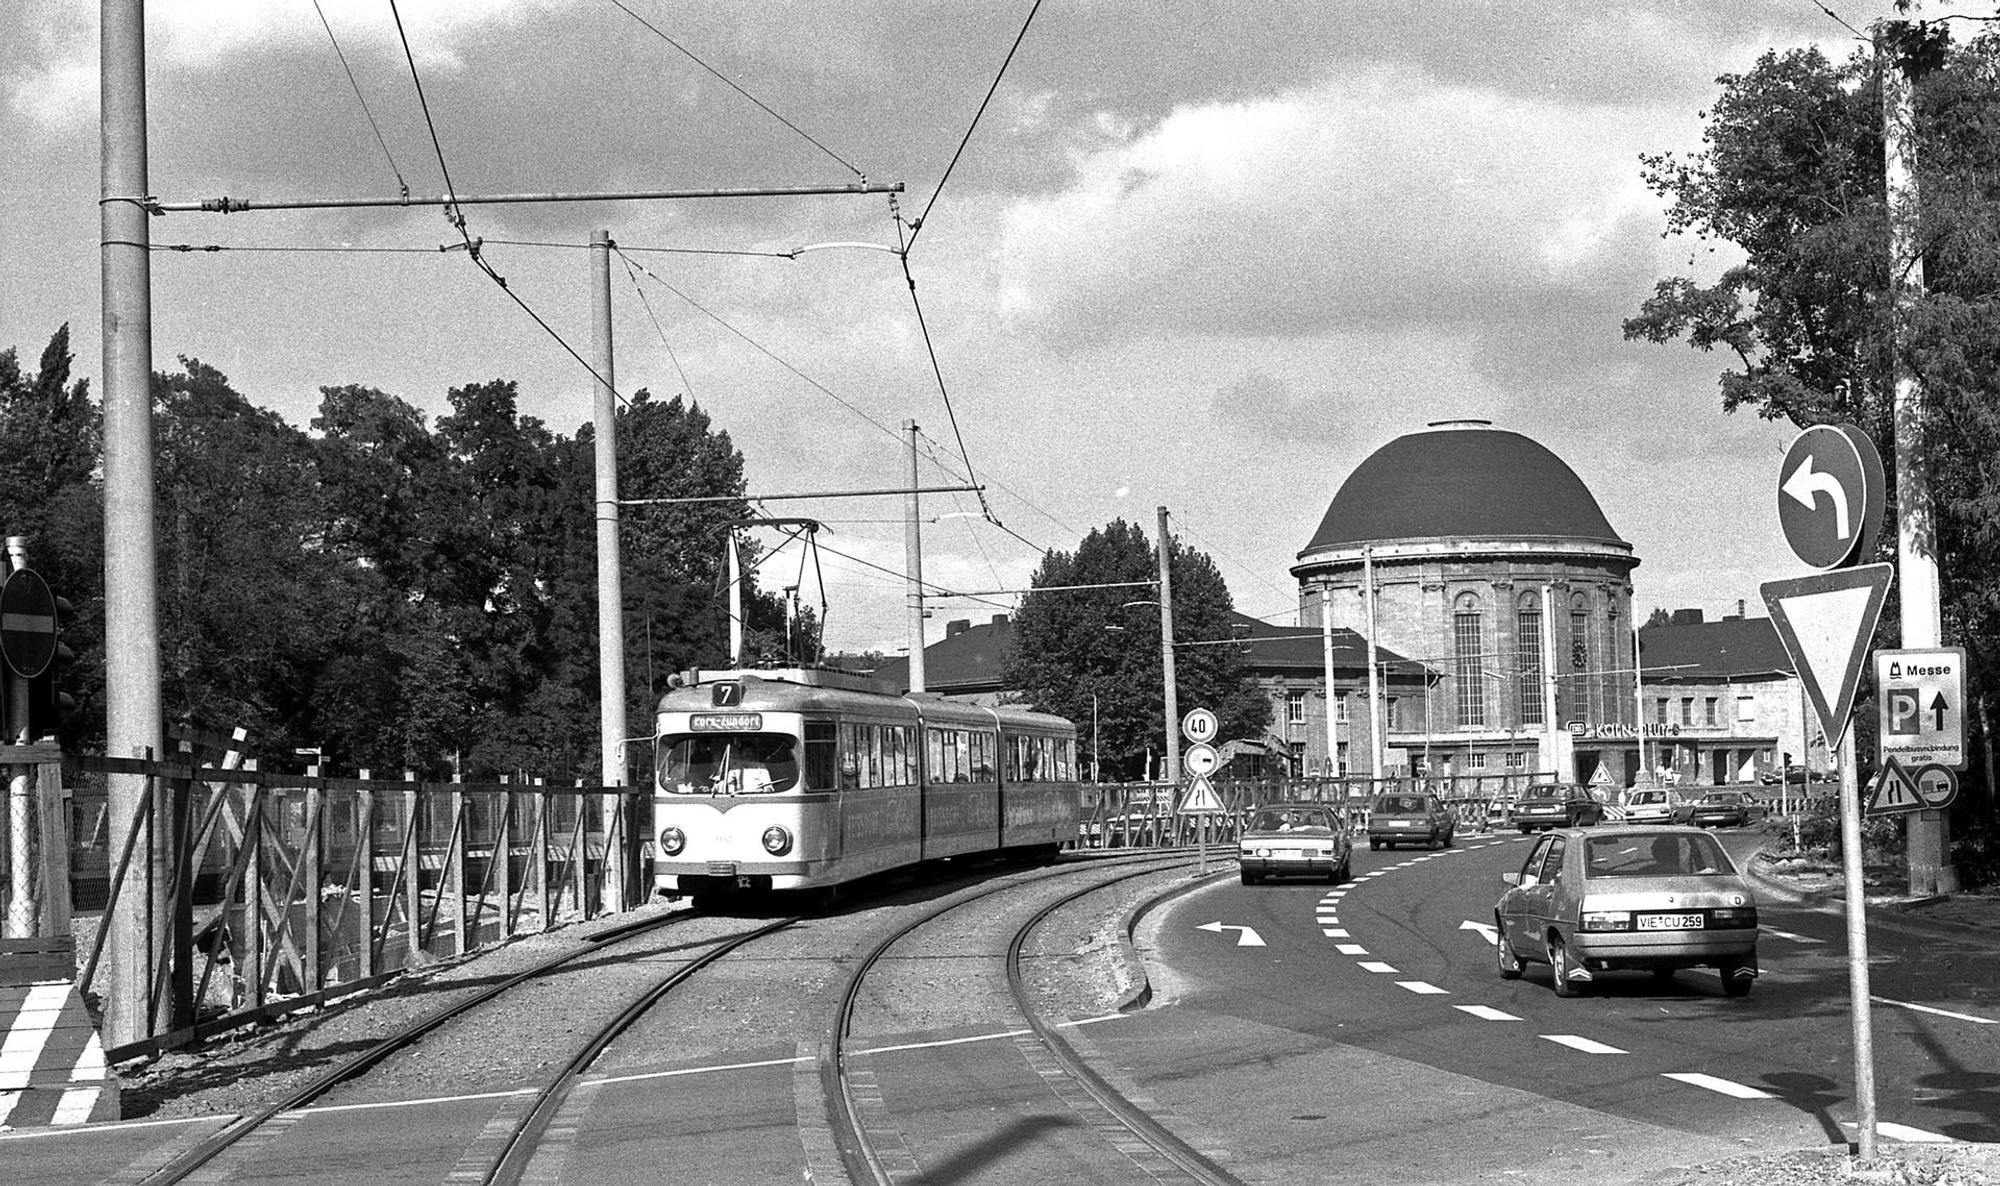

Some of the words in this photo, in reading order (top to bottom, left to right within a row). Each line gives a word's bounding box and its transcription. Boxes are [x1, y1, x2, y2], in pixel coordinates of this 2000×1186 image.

[1906, 665, 1951, 676] Messe
[721, 685, 732, 704] 7
[1892, 694, 1917, 731] P
[1191, 719, 1205, 733] 40
[1682, 915, 1702, 927] 259
